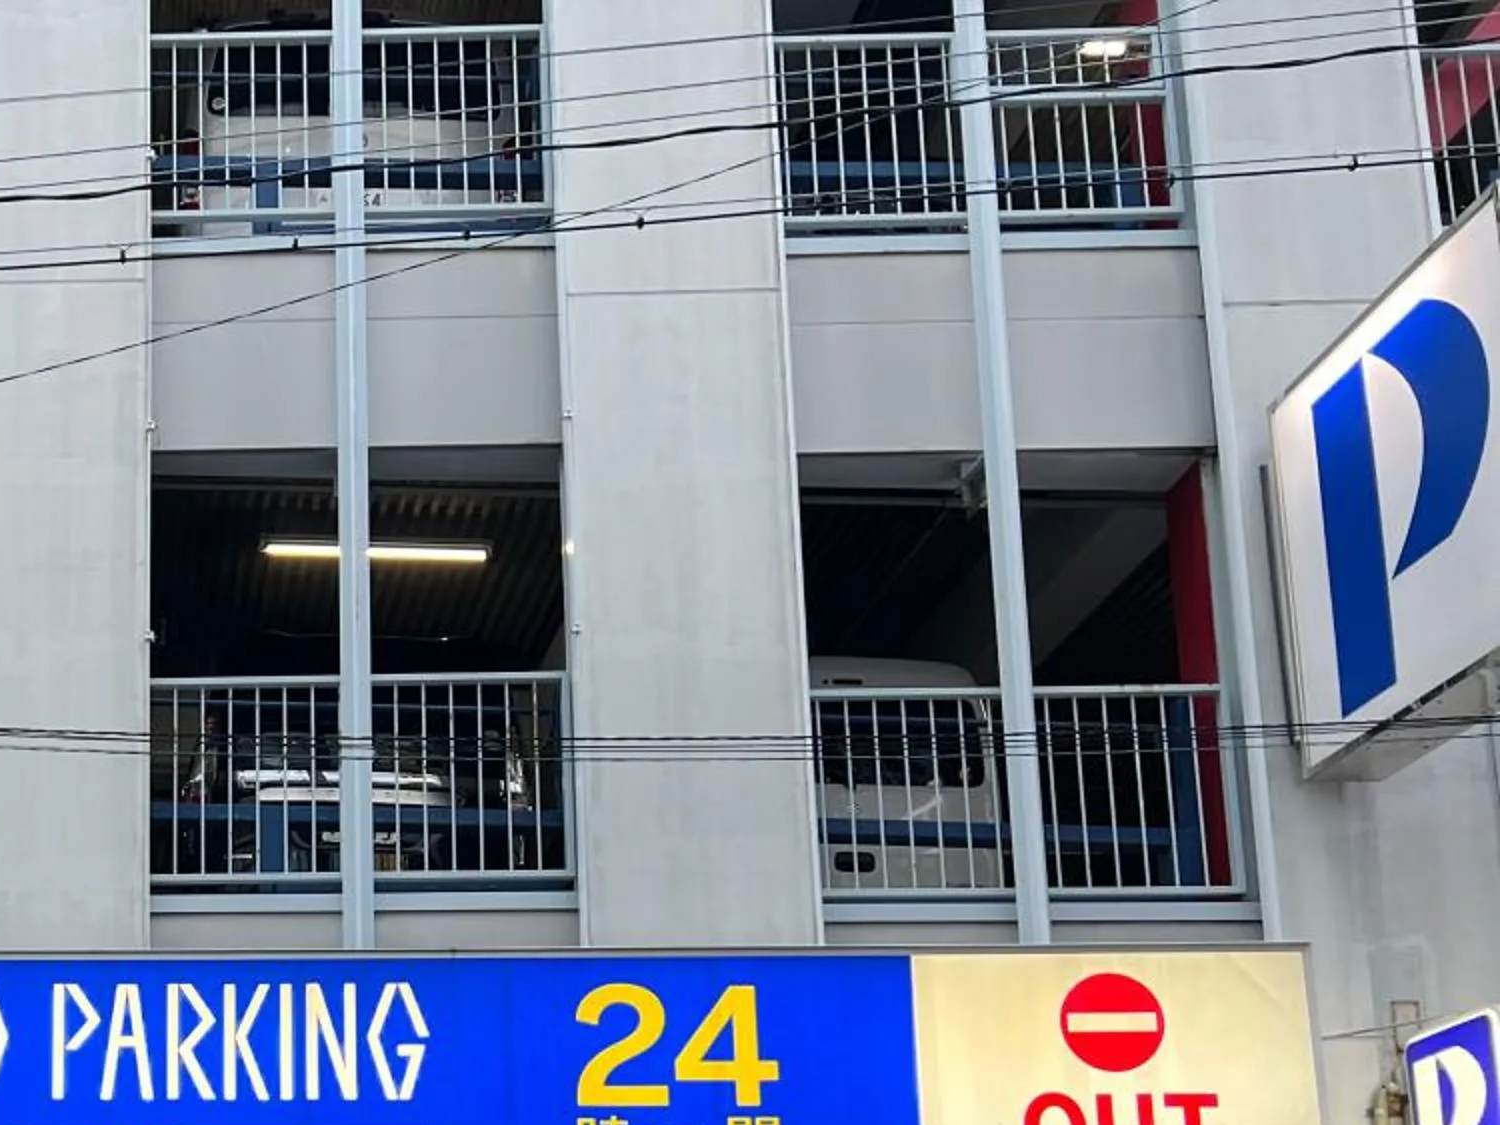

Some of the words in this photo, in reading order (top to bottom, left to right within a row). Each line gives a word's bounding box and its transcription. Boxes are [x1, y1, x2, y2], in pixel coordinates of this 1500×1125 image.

[1311, 298, 1491, 719] P
[51, 982, 432, 1101] PARKING
[575, 983, 780, 1107] 24
